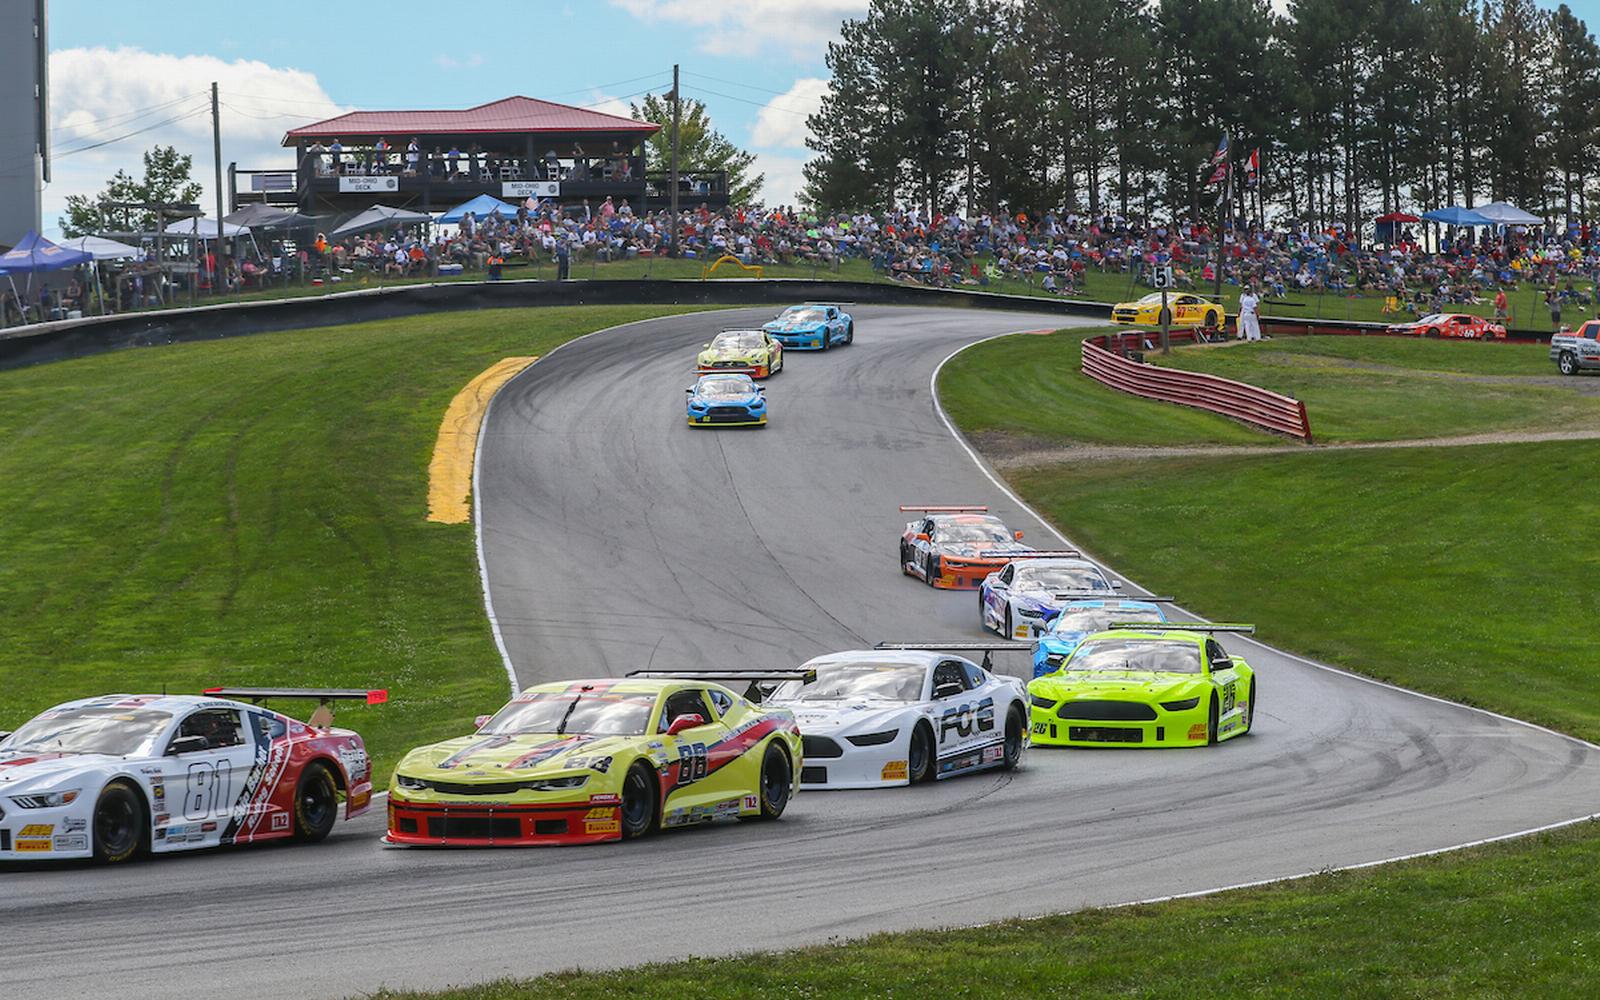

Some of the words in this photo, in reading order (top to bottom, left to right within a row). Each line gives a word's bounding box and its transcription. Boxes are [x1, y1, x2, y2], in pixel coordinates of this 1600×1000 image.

[1155, 267, 1167, 287] 5
[1033, 721, 1047, 735] 26
[246, 744, 268, 794] Barber
[182, 758, 233, 821] 81
[17, 841, 49, 850] PIRELLI
